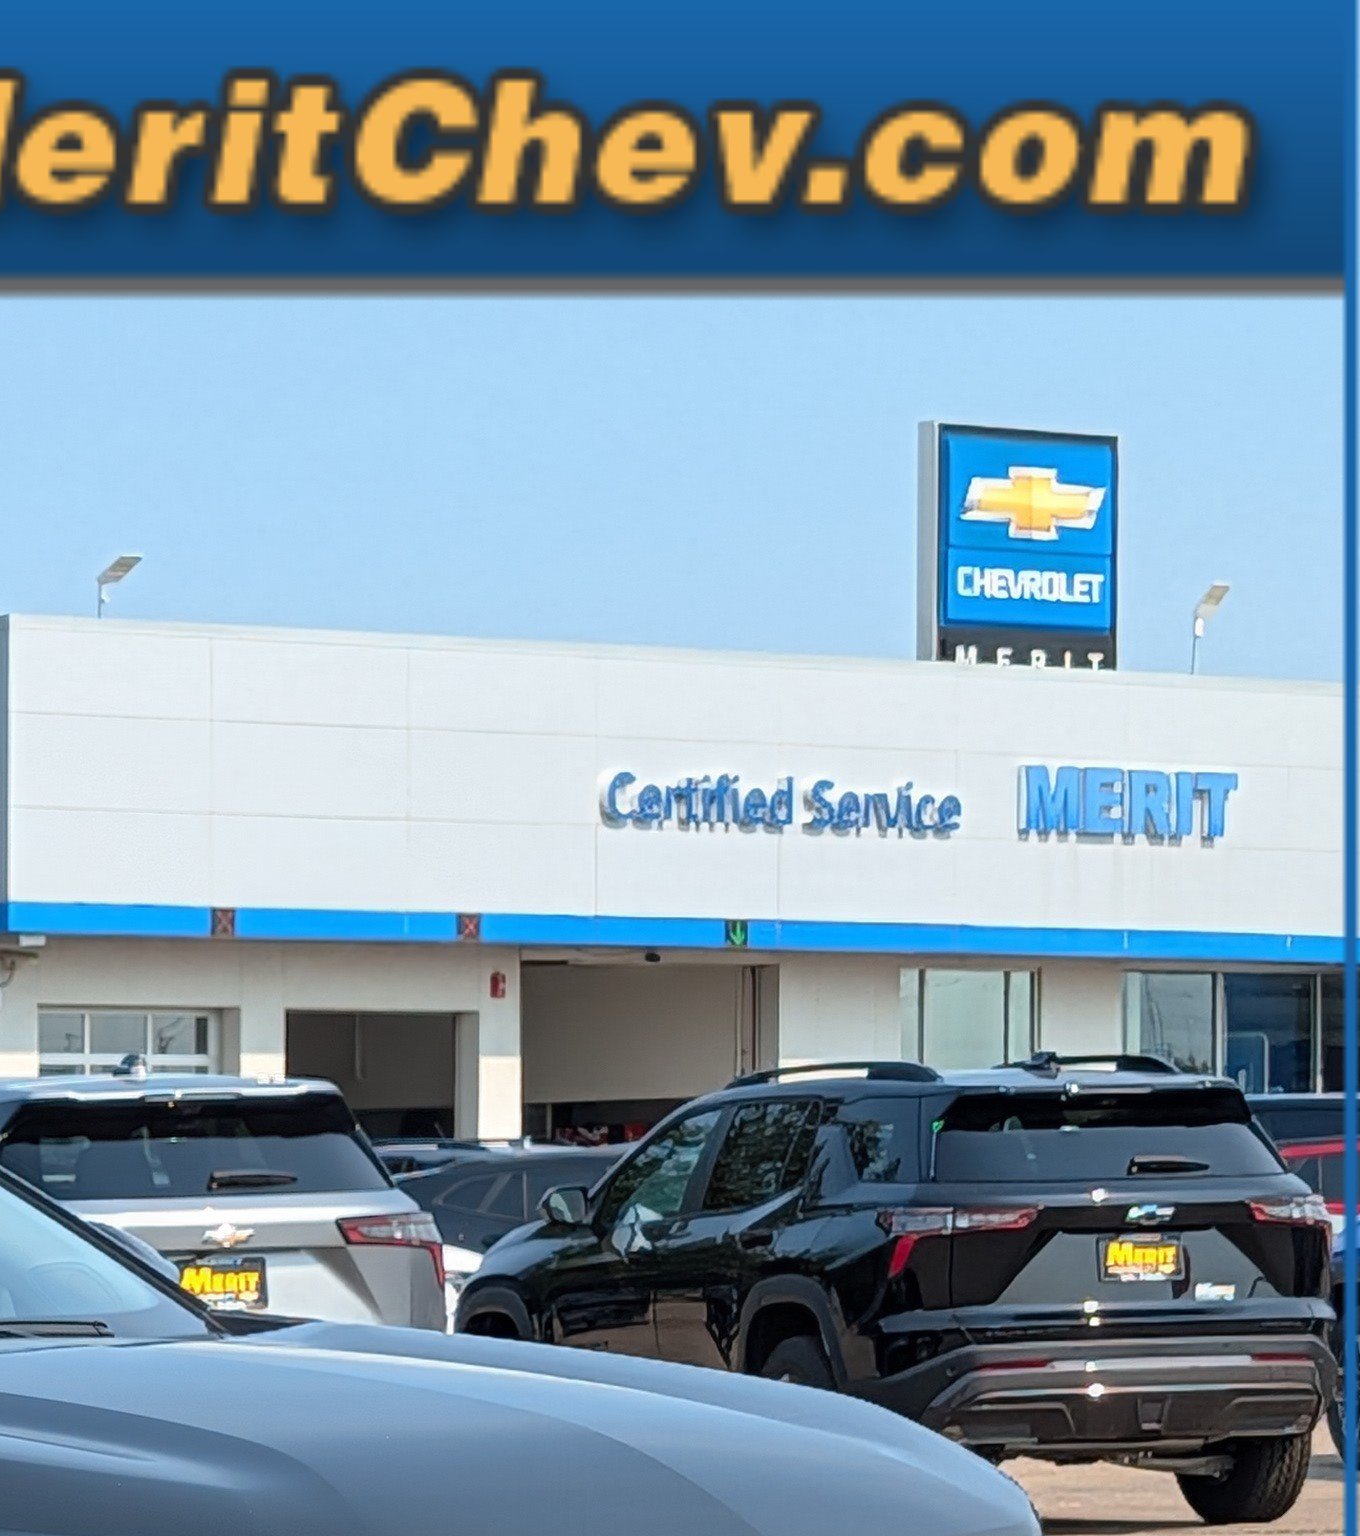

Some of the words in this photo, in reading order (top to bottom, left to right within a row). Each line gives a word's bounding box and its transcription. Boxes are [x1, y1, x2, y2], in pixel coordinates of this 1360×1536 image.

[957, 566, 1105, 603] CHEVROLET
[600, 771, 795, 834] Certified
[803, 780, 963, 838] Service
[1018, 766, 1239, 845] MERIT
